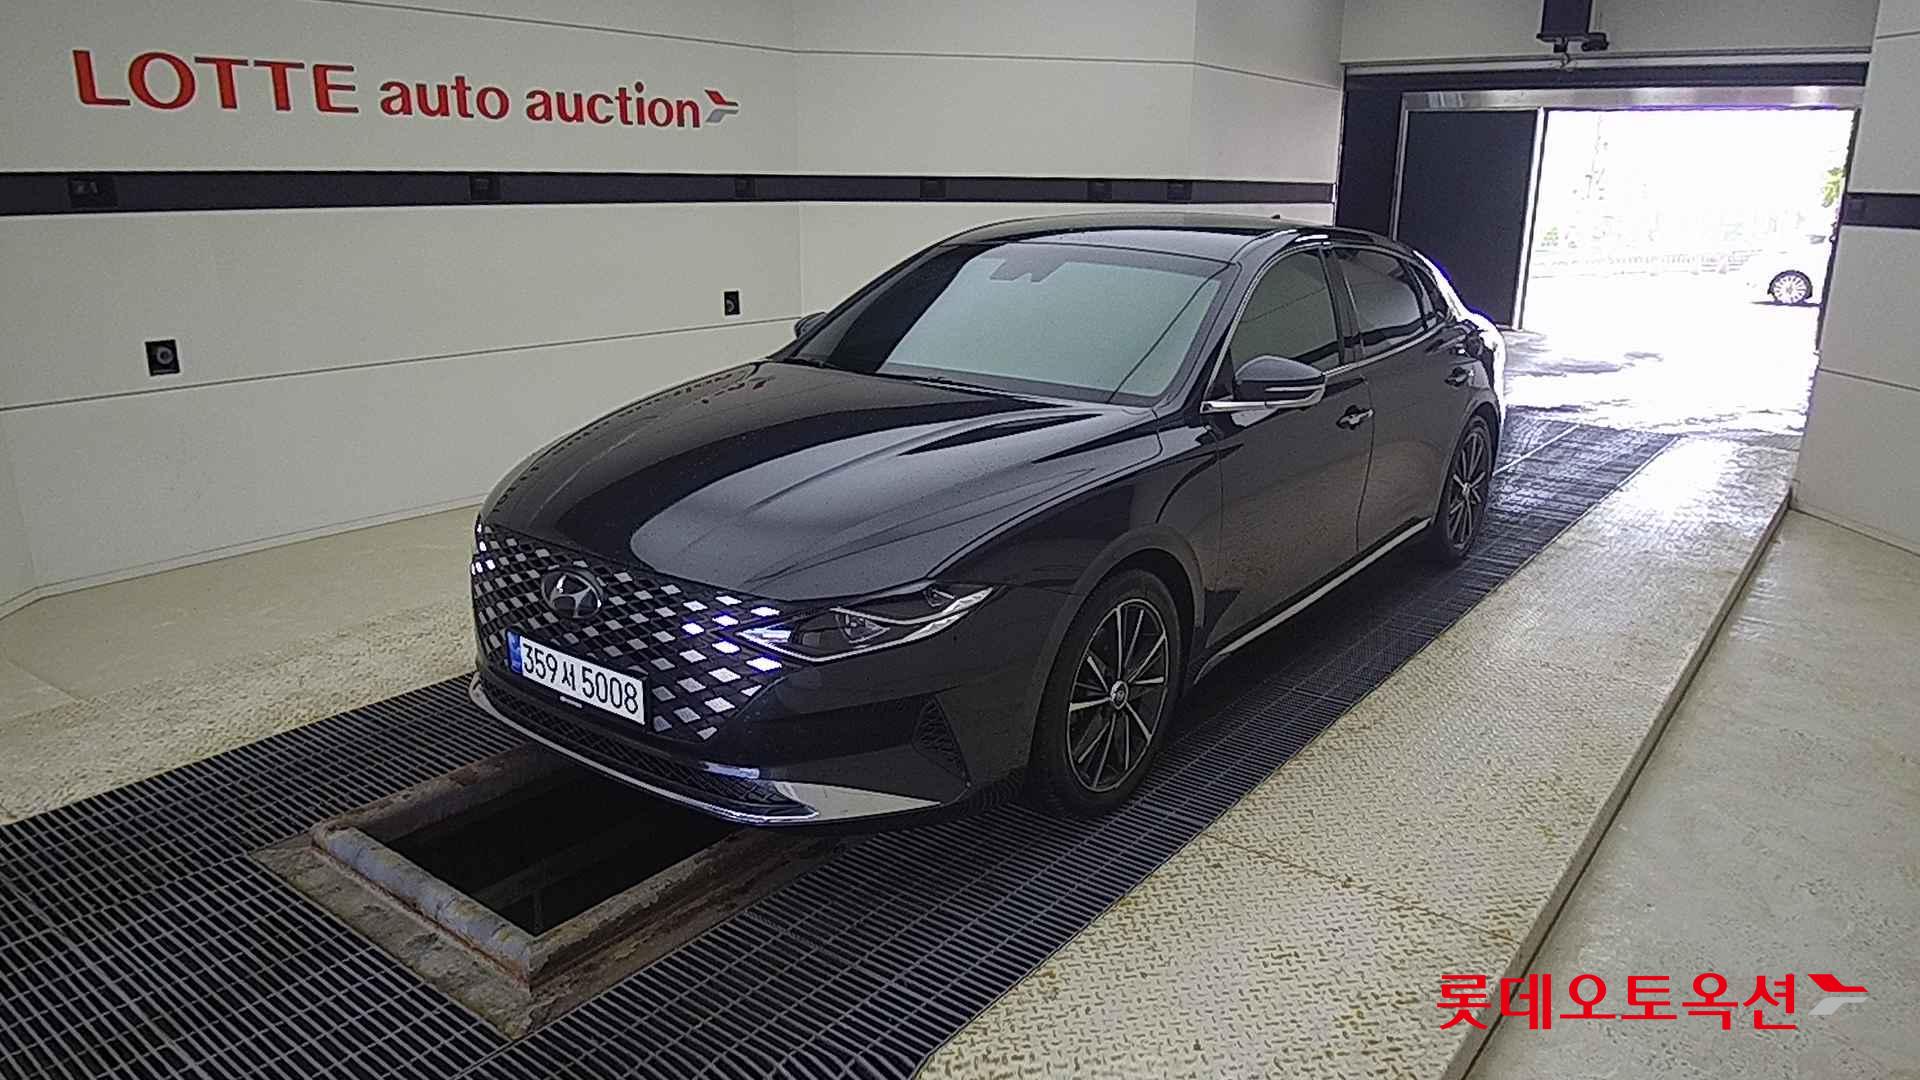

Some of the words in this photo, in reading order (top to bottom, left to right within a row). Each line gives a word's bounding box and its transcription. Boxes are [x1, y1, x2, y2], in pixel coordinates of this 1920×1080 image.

[72, 50, 359, 113] LOTTE
[380, 76, 510, 120] auto
[526, 82, 701, 128] auction
[582, 665, 639, 714] 5008
